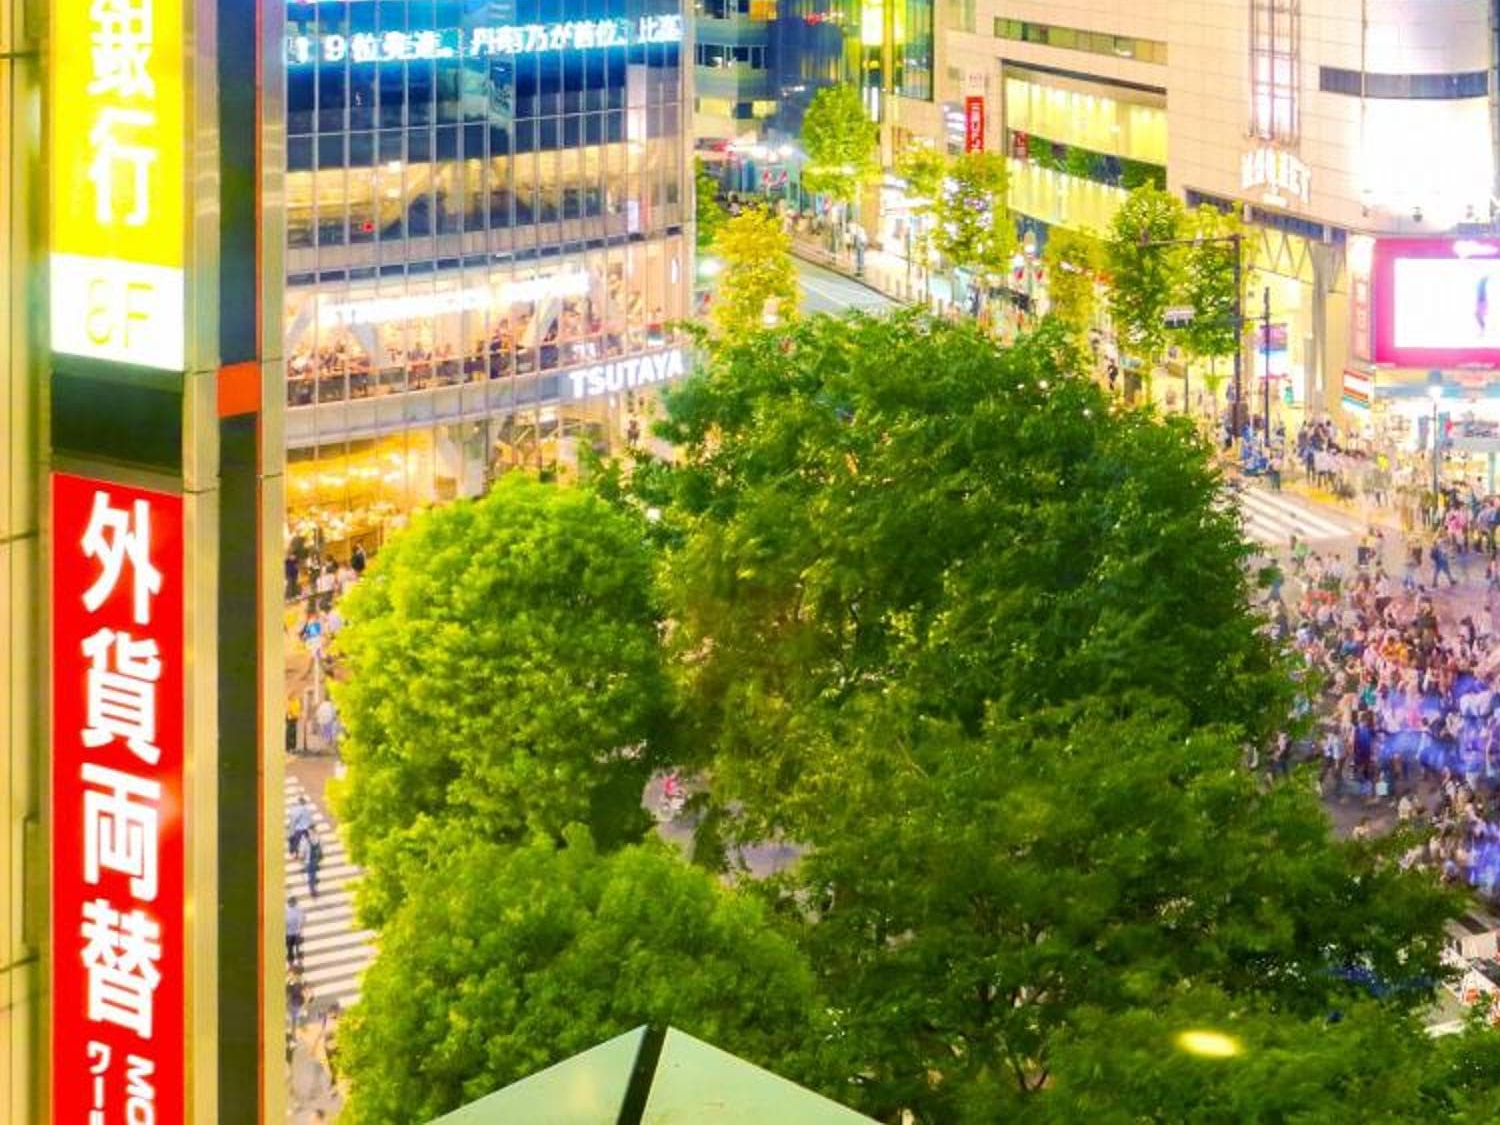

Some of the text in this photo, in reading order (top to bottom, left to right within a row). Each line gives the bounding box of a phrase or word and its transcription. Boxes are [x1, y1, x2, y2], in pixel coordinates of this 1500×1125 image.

[568, 349, 684, 400] TSUTAYA
[80, 490, 163, 1040] 外貨両替
